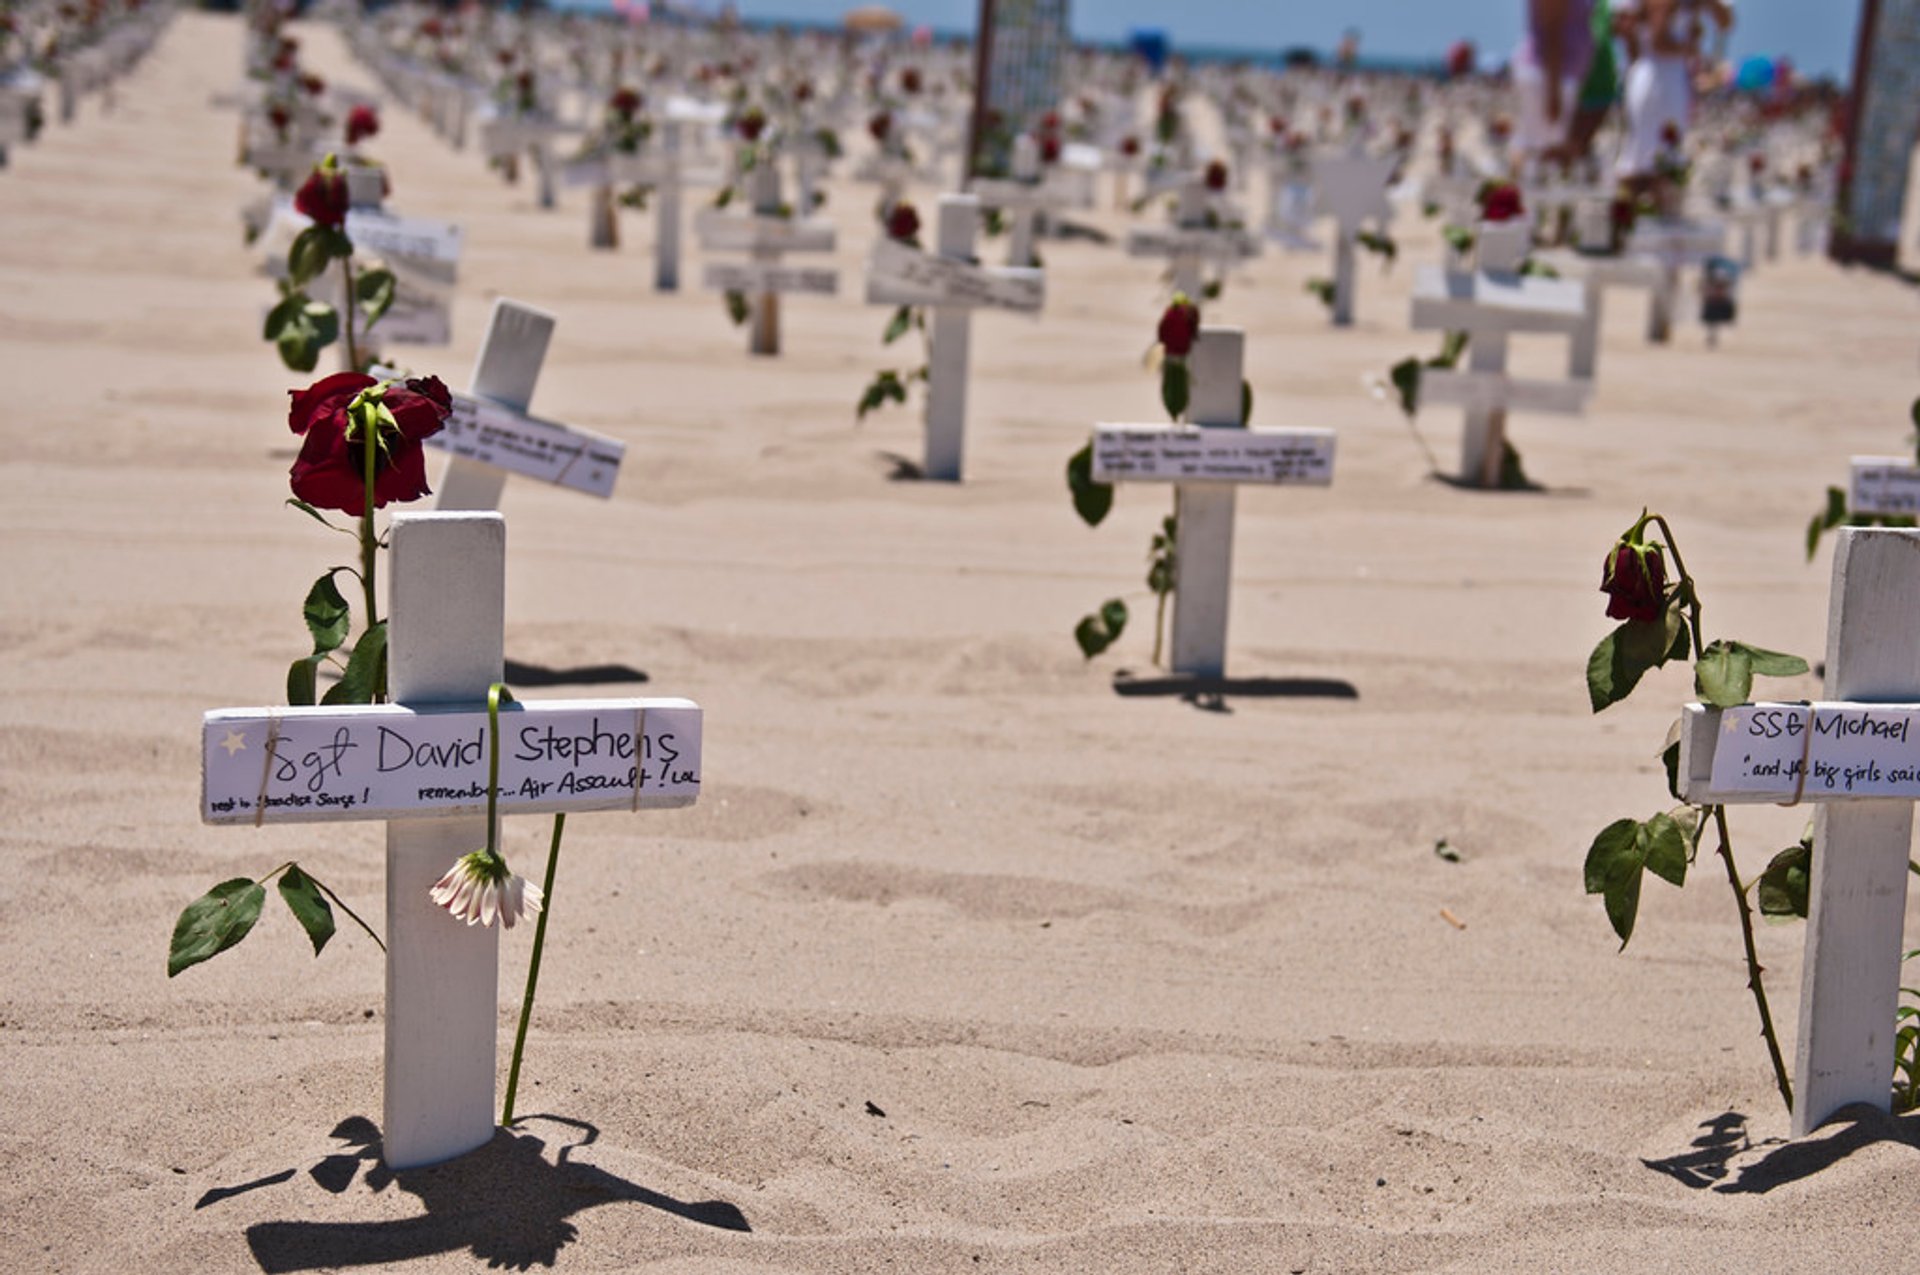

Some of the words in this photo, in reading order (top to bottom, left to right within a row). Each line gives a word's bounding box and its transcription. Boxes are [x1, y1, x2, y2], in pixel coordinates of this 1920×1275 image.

[1749, 712, 1804, 738] SSG
[1815, 712, 1910, 743] Michael
[264, 726, 358, 792] Sgt
[377, 725, 484, 772] David
[515, 718, 679, 766] Stephens
[519, 778, 554, 799] Air
[1814, 760, 1841, 788] big
[1843, 760, 1880, 790] girls
